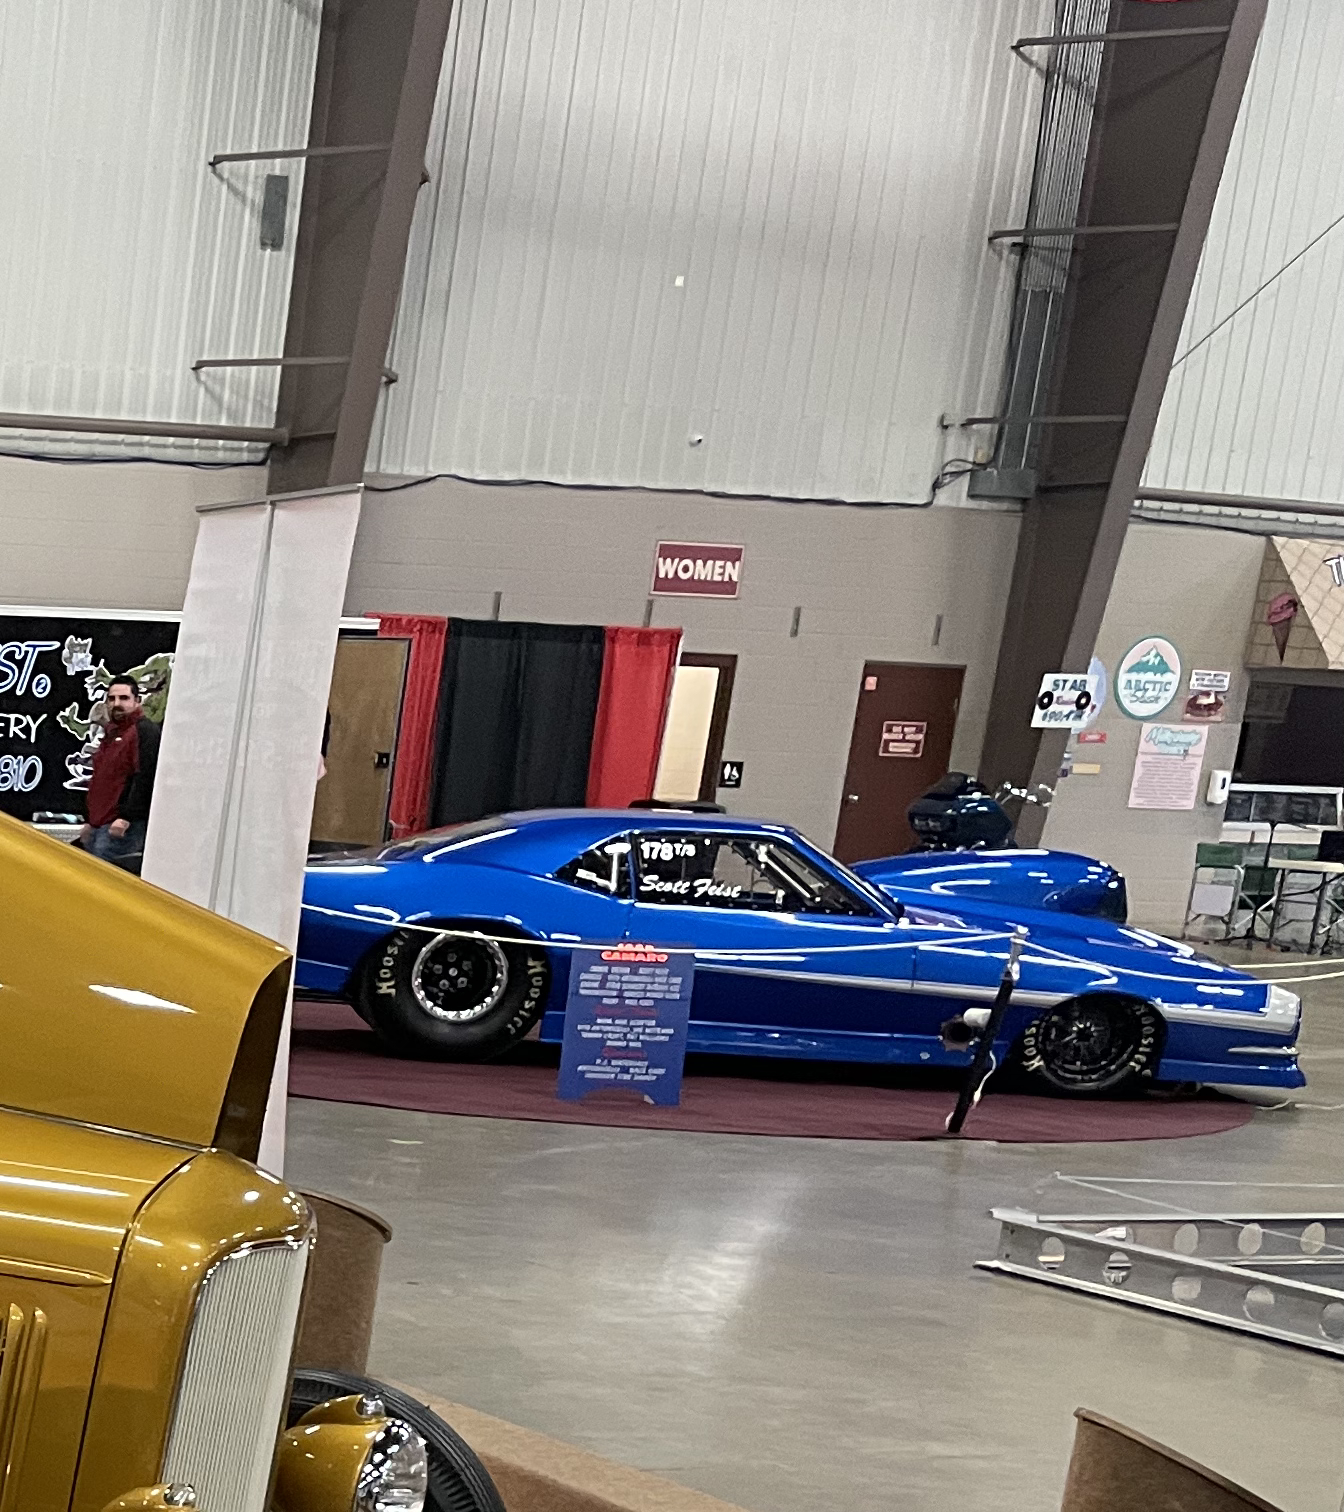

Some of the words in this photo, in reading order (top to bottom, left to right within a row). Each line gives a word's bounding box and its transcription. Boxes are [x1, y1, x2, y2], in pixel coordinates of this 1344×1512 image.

[658, 557, 740, 582] WOMEN
[641, 841, 674, 861] 178
[639, 874, 691, 895] Scott
[693, 878, 742, 898] Feist
